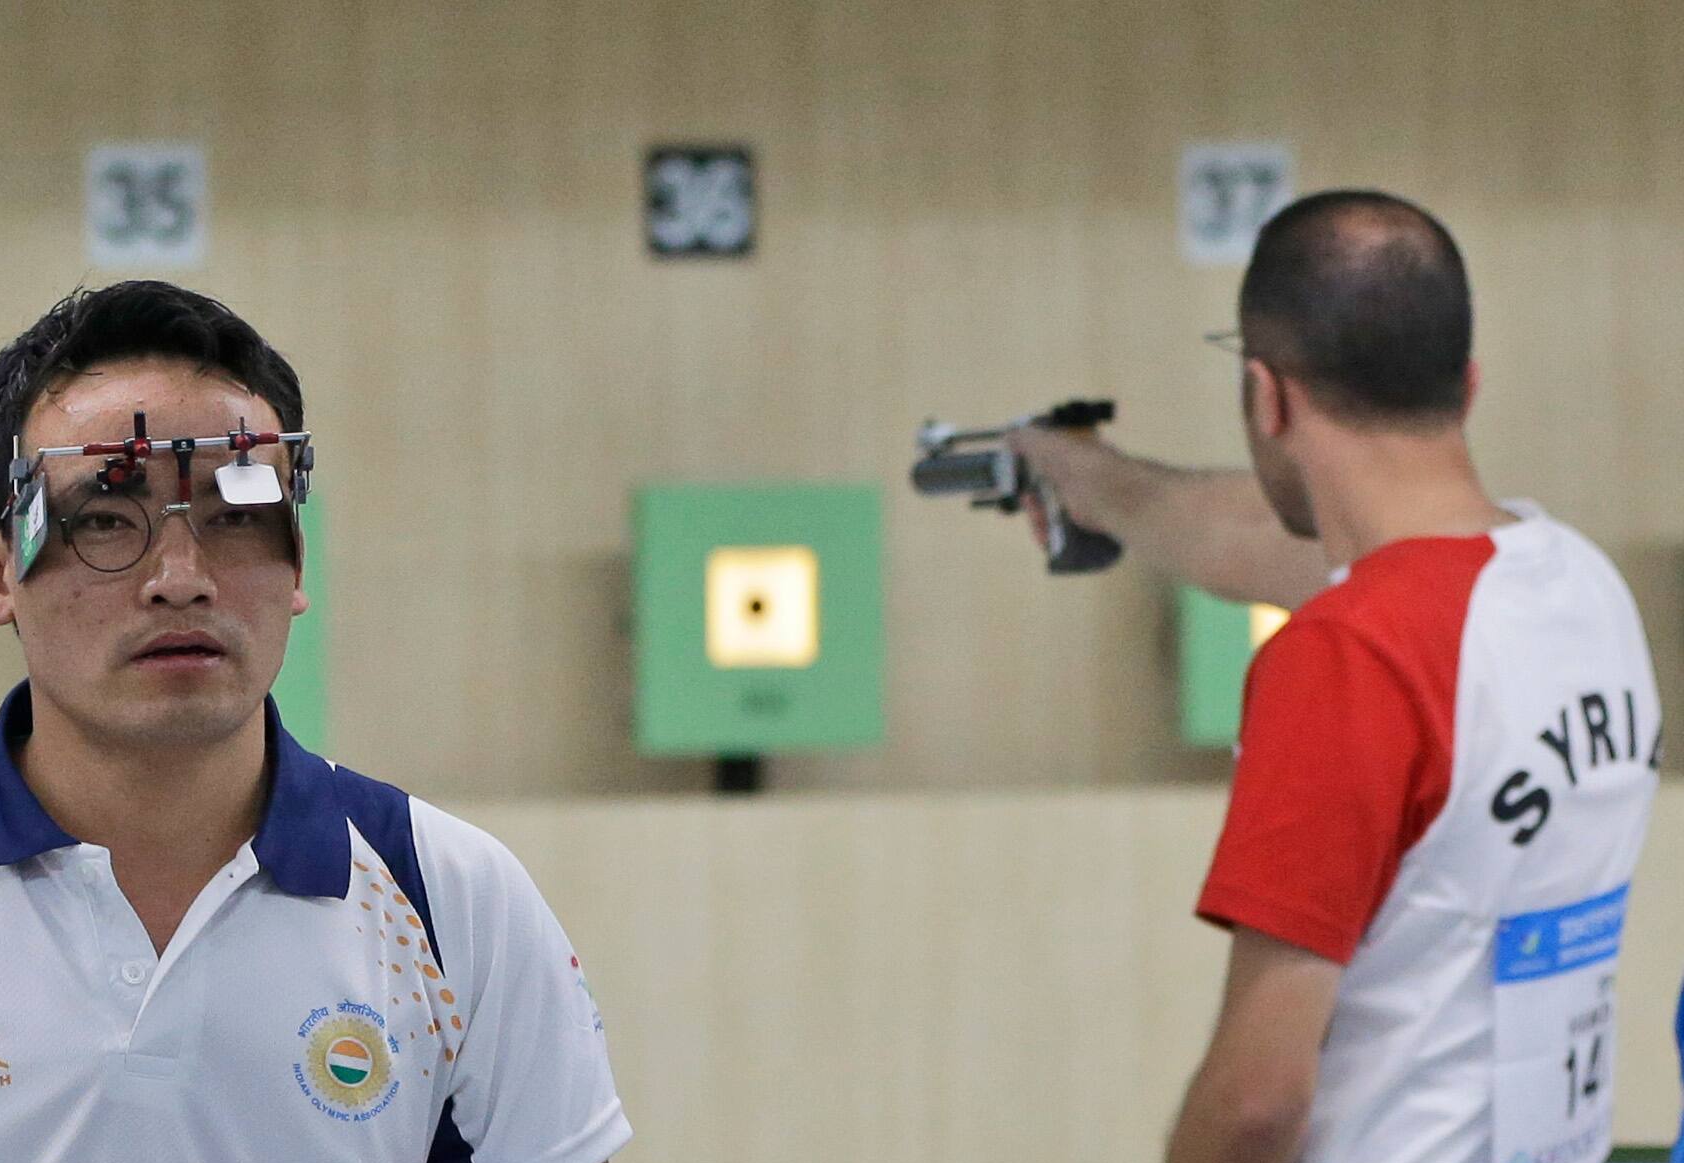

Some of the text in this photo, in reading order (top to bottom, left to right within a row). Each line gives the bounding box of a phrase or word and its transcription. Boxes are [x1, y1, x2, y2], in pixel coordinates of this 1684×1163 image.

[99, 161, 193, 245] 35
[651, 159, 749, 247] 36
[1194, 160, 1283, 242] 37
[293, 1063, 400, 1122] INDIAN OLYMPIC ASSOCIATION
